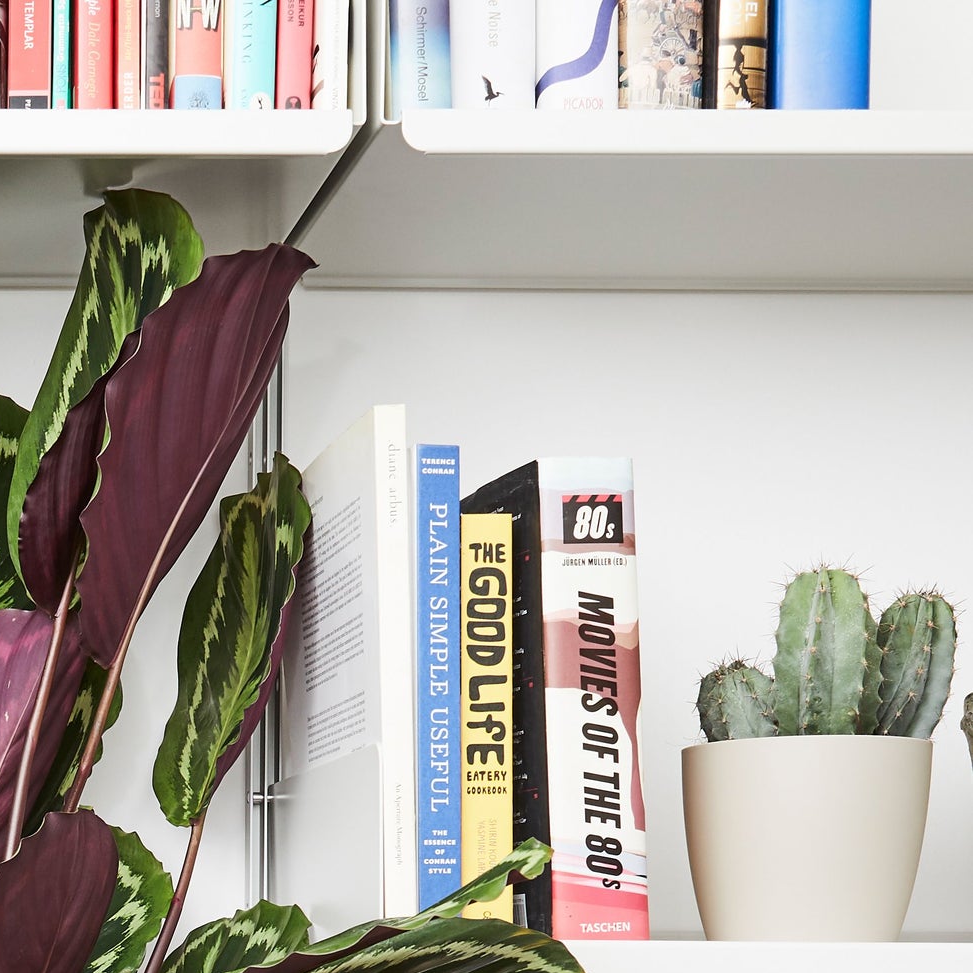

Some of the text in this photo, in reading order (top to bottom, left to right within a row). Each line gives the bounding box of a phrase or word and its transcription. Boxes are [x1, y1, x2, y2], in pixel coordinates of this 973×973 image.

[23, 1, 35, 50] TEMPLAR
[87, 21, 101, 47] Dale
[488, 11, 502, 49] Noise
[415, 6, 429, 103] Schirmer/Mosel
[57, 64, 67, 94] PONS
[83, 50, 101, 99] Carnegie
[563, 98, 604, 110] PICADOR
[421, 467, 455, 475] CONRAN
[573, 505, 615, 540] 80s
[469, 542, 507, 563] THE
[562, 556, 586, 567] JÜRGEN
[587, 555, 612, 566] MÜLLER
[429, 502, 450, 812] PLAIN SIMPLE USEFUL
[466, 566, 507, 766] GOOD LIFE
[576, 591, 623, 890] MOVIES OF THE 80s
[466, 770, 507, 782] EATERY
[466, 785, 508, 795] COOKBOOK
[477, 820, 486, 855] YASMINE
[488, 818, 497, 847] SHIRIN
[579, 920, 632, 934] TASCHEN
